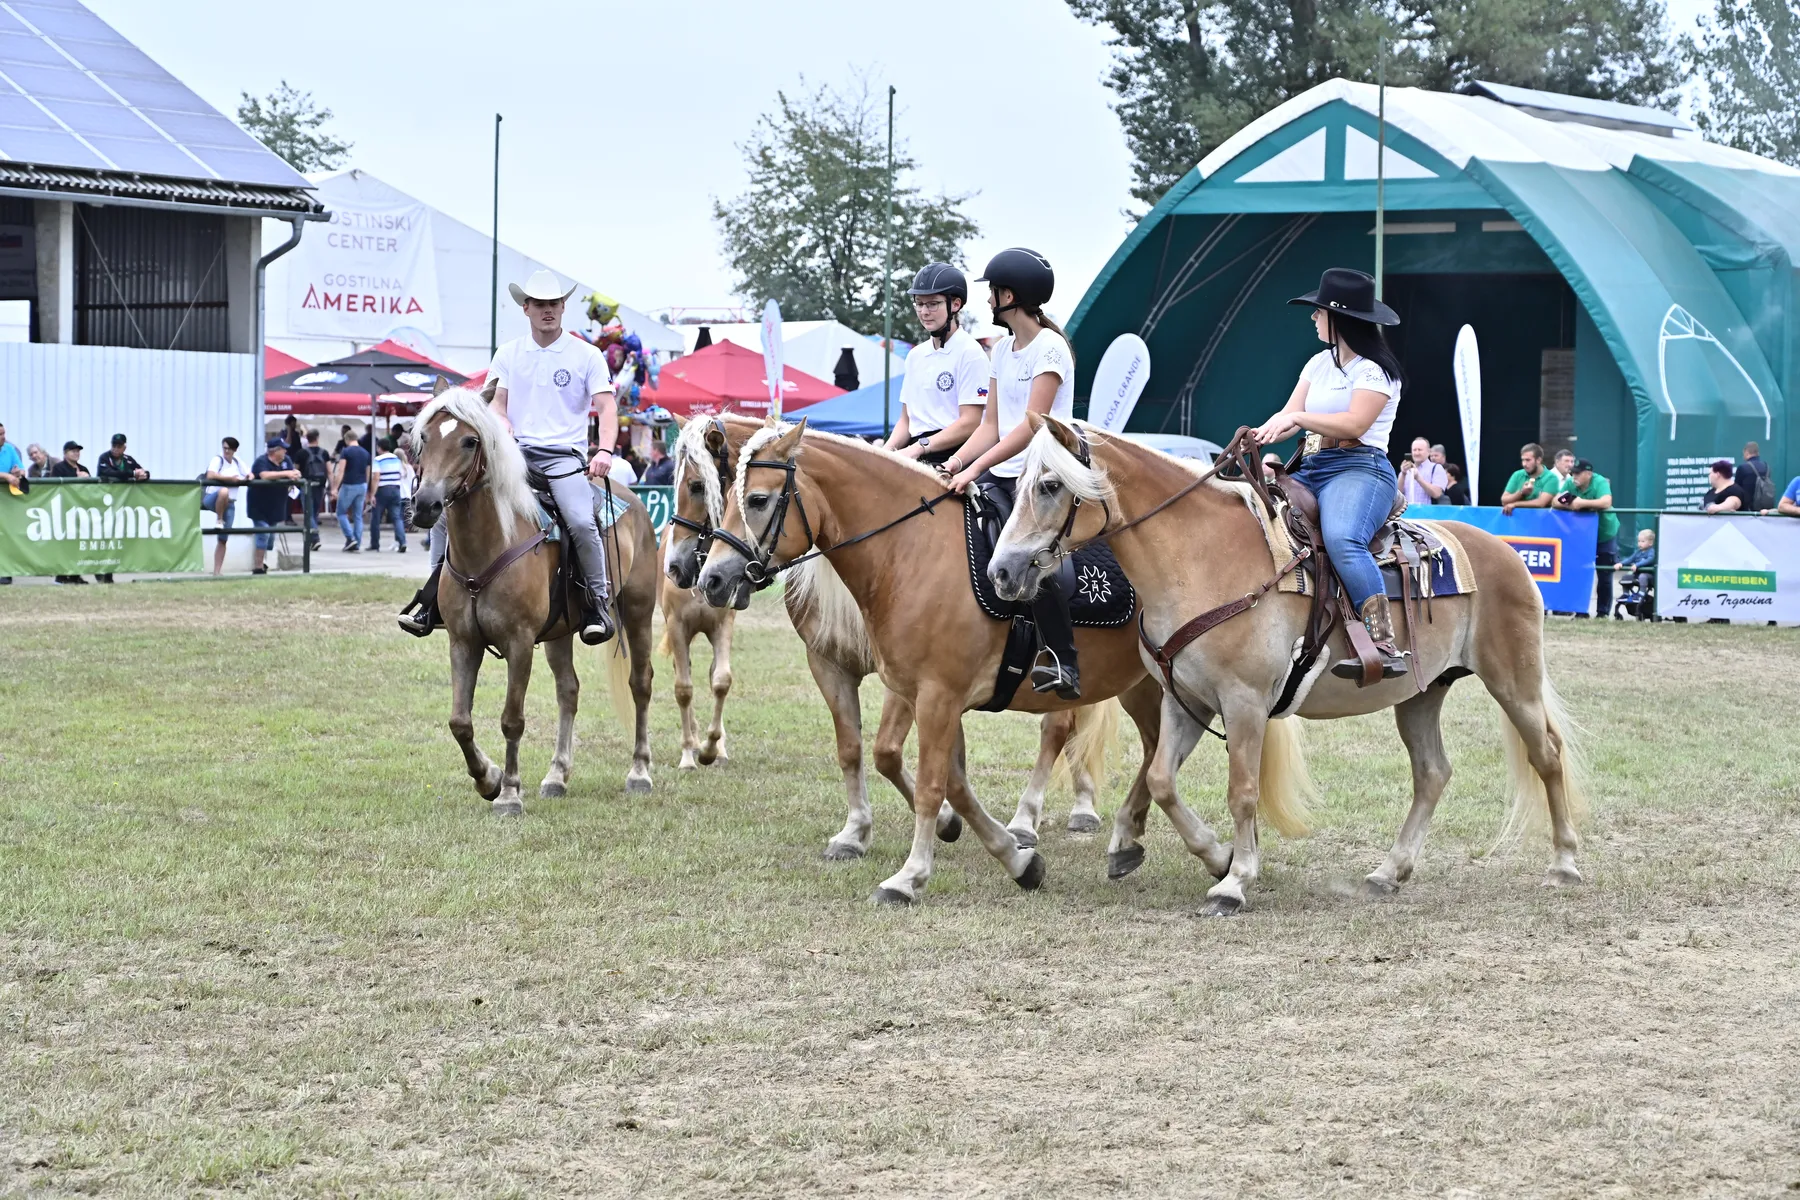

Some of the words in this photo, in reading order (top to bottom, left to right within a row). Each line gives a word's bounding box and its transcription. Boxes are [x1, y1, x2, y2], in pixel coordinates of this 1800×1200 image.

[328, 210, 411, 231] OSTINSKI
[327, 233, 398, 252] CENTER
[323, 273, 402, 290] GOSTILNA
[302, 283, 424, 315] AMERIKA
[1101, 400, 1121, 430] ROSA
[1118, 355, 1142, 398] GRANDE
[26, 493, 172, 541] almima
[79, 540, 123, 551] EMBAL
[1519, 550, 1551, 567] FER
[1694, 574, 1768, 586] RAIFFEISEN
[1677, 594, 1711, 609] Agro
[1716, 593, 1773, 609] Trgovina
